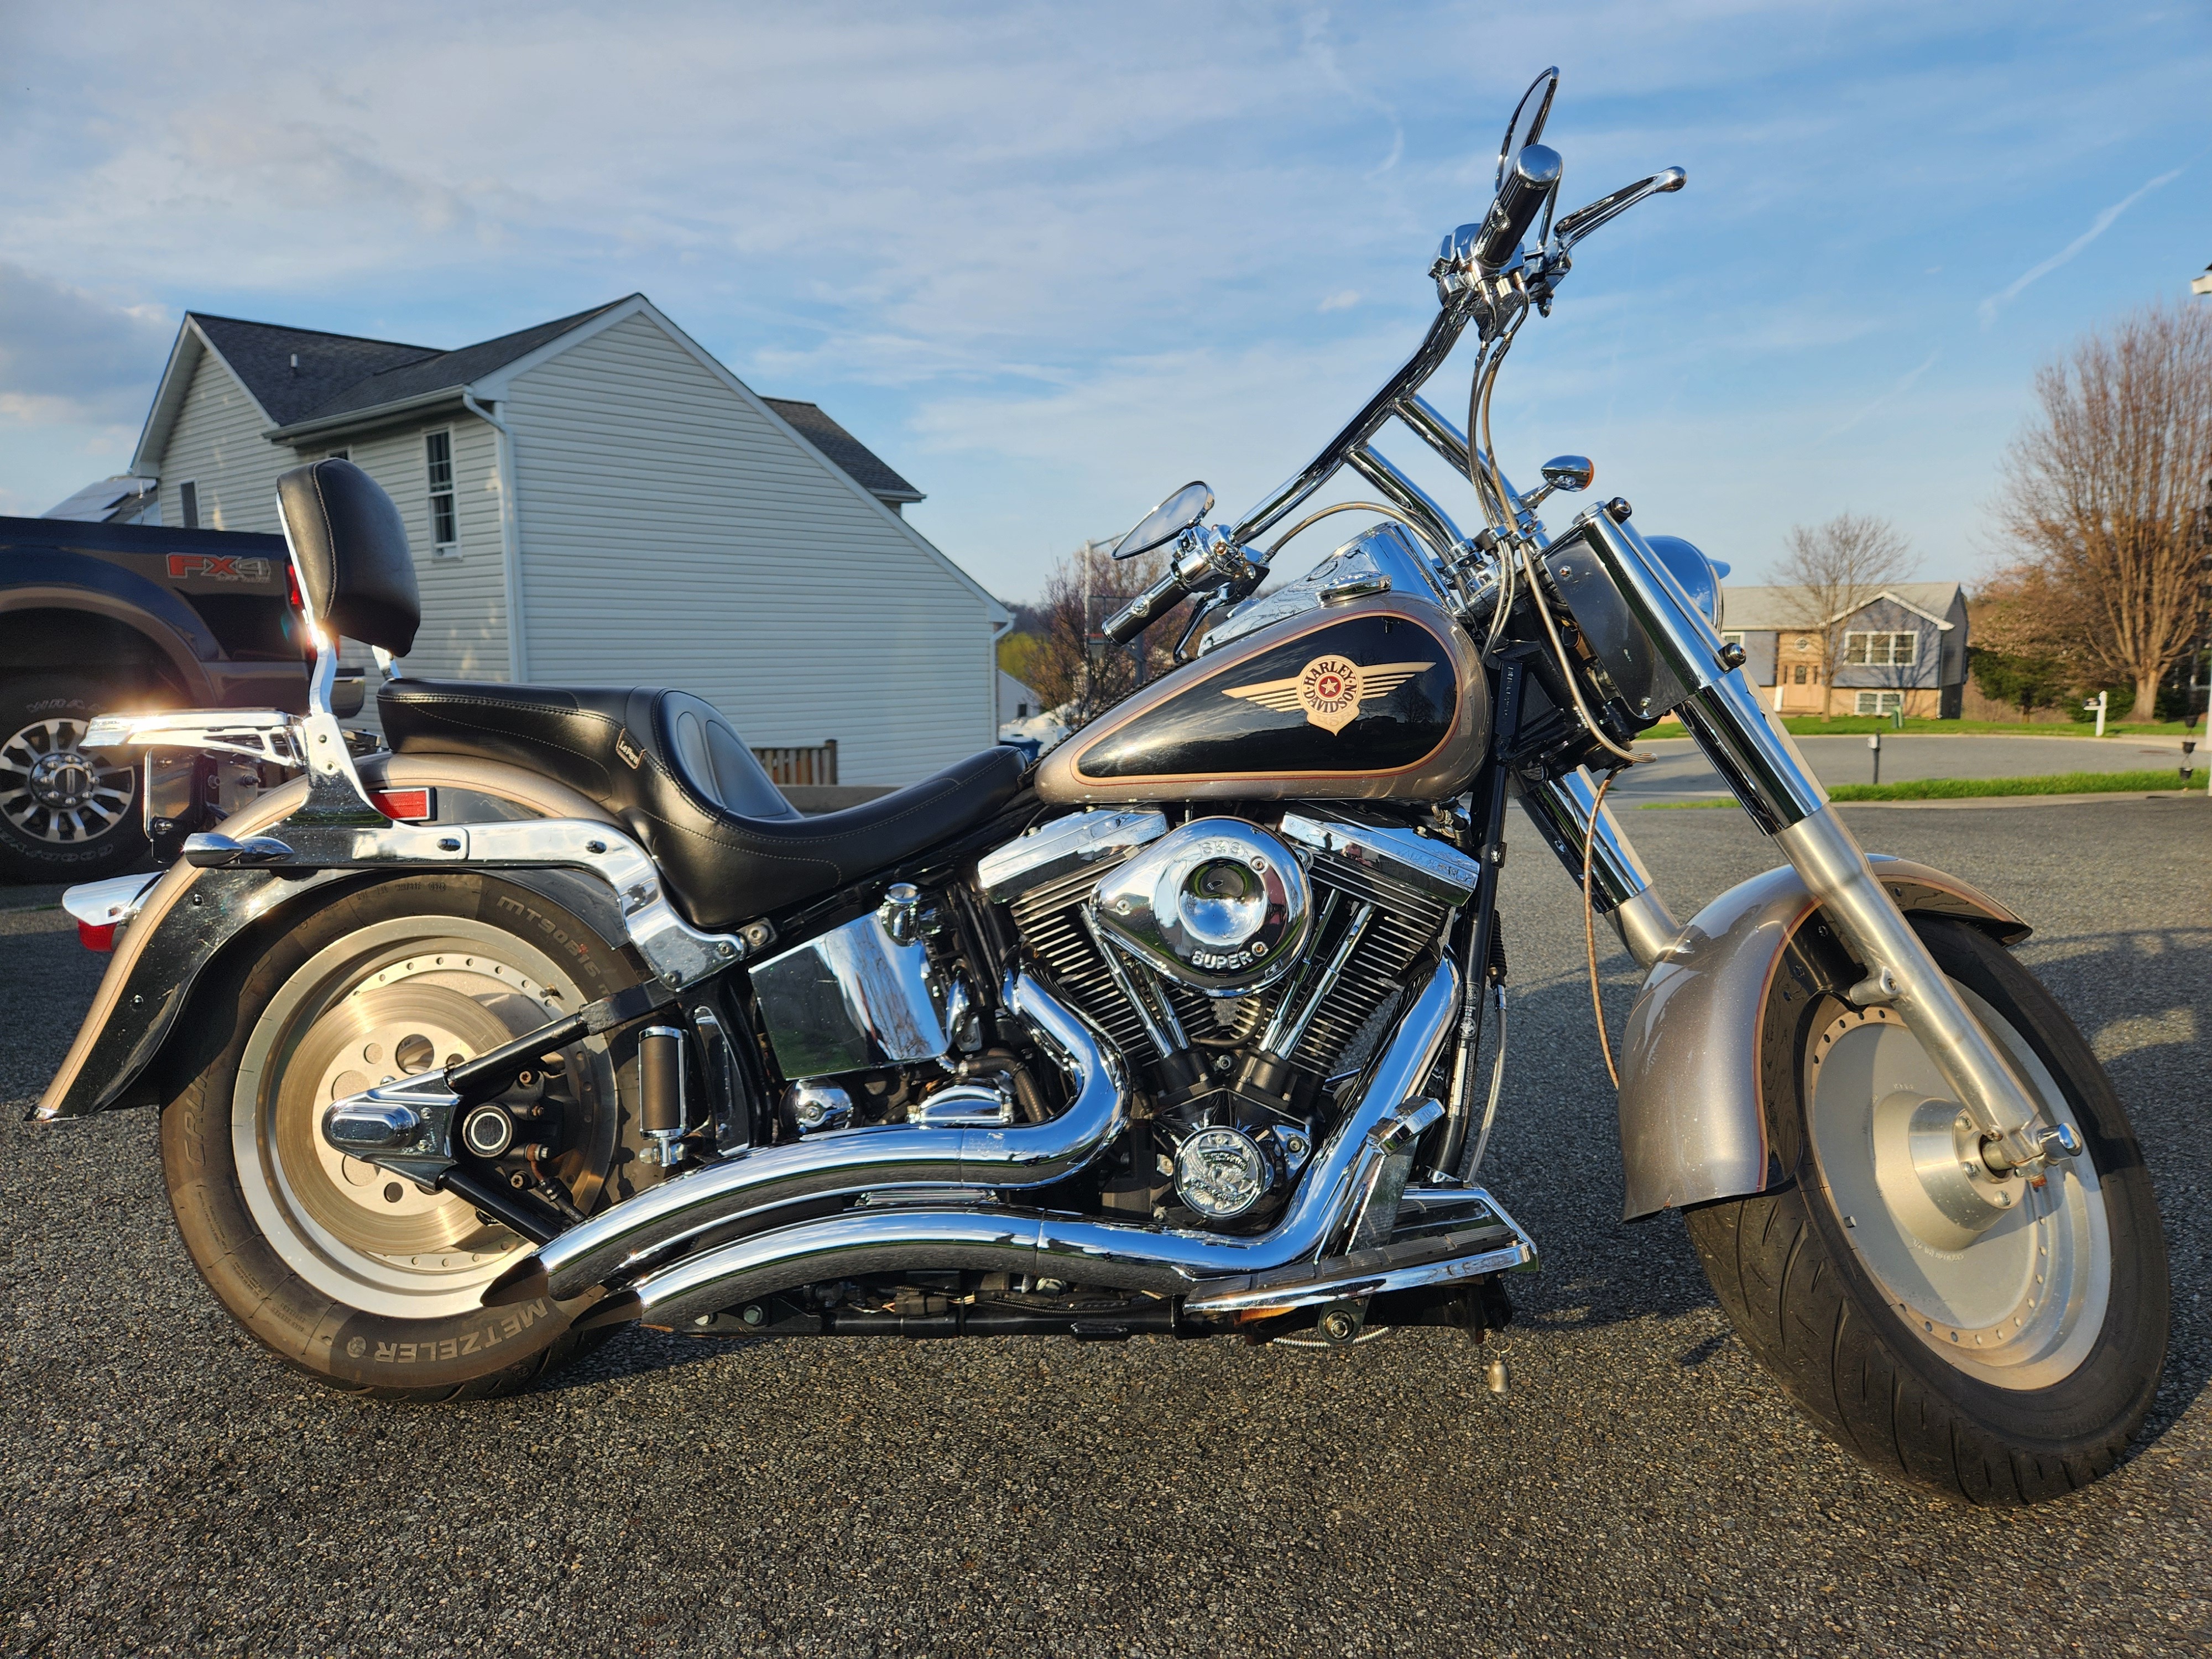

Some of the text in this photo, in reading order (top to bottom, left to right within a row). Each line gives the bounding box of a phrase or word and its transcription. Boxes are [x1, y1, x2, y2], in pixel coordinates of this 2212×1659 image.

[166, 552, 271, 579] FX4
[1303, 661, 1357, 686] HARLEY
[1303, 685, 1358, 713] DAVIDSON
[1191, 949, 1254, 969] SUPER
[374, 1298, 549, 1363] METZELER
